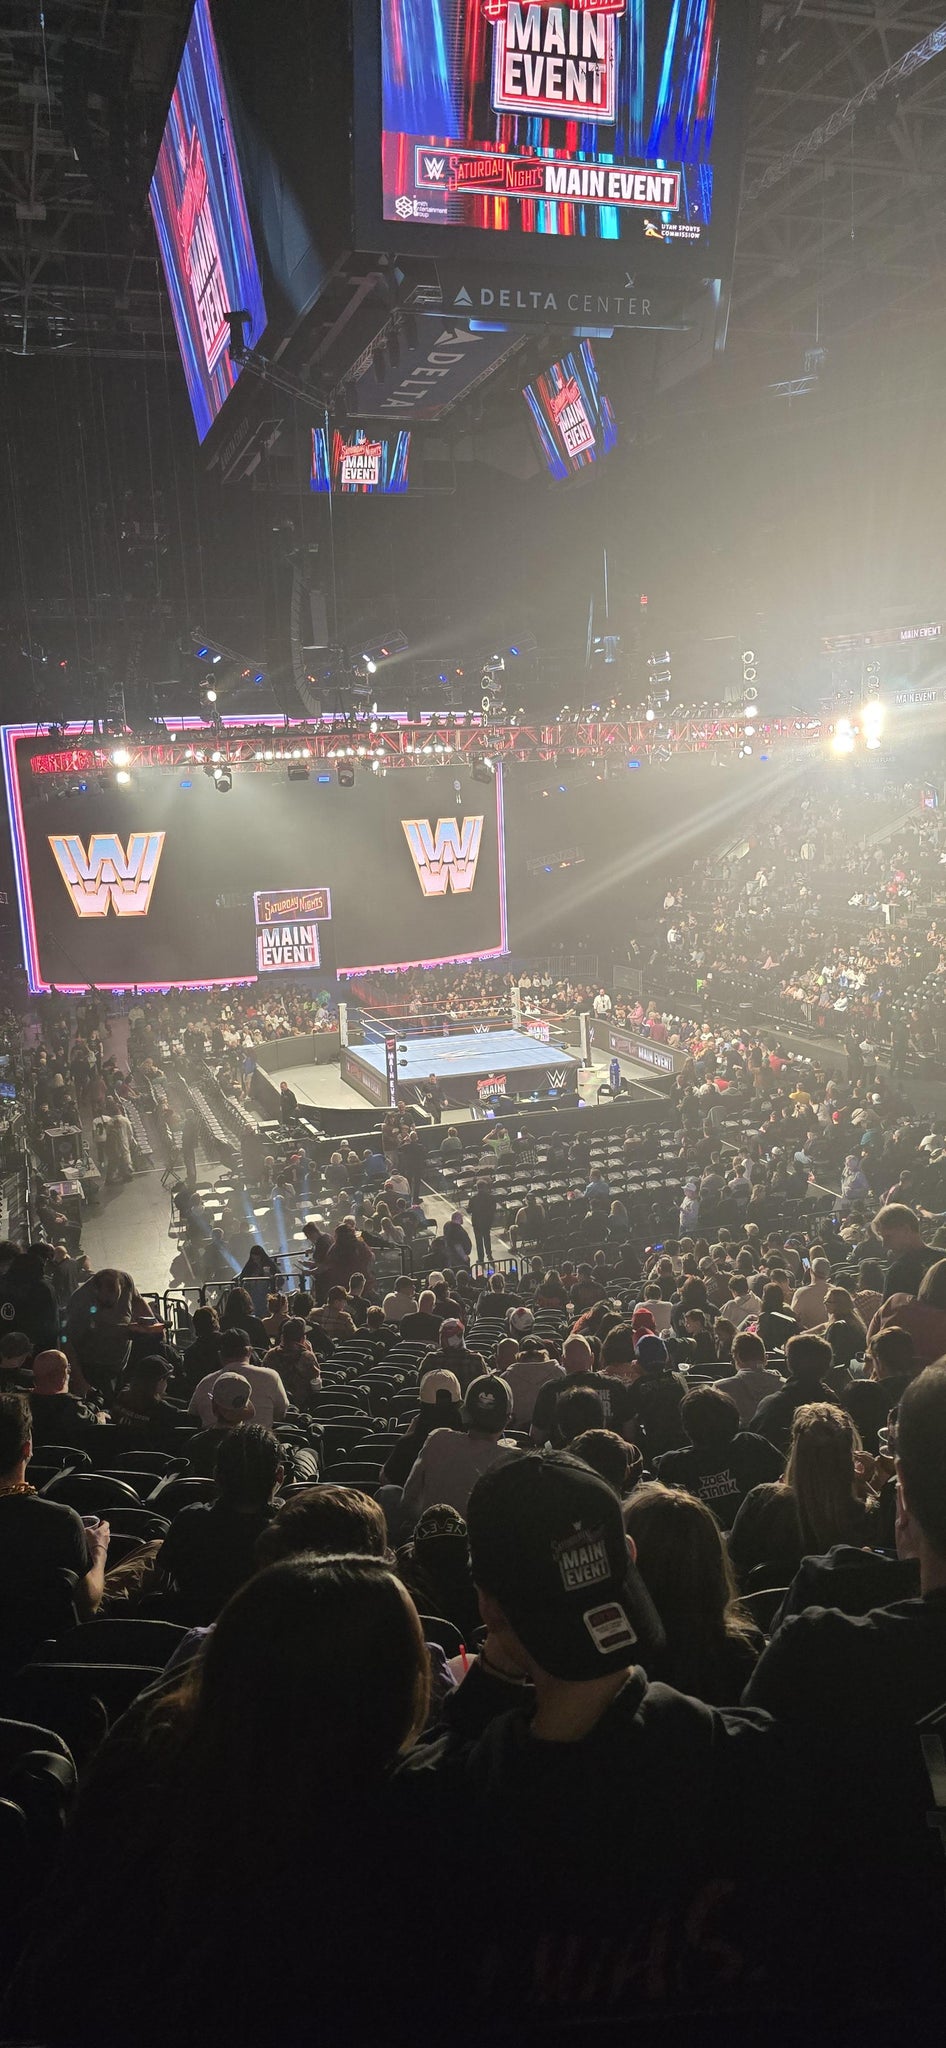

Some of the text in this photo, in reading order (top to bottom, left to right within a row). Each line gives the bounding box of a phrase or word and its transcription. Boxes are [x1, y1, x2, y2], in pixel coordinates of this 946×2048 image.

[506, 1, 606, 59] MAIN
[504, 52, 606, 104] EVENT
[545, 166, 605, 197] MAIN
[608, 172, 675, 203] EVENT
[661, 230, 701, 239] COMMISSION
[480, 288, 651, 316] DELTA CENTER
[380, 352, 465, 410] DELTA
[345, 468, 375, 480] EVENT
[346, 457, 375, 469] MAIN
[900, 626, 942, 641] MAIN EVENT
[896, 691, 937, 703] MAIN EVENT
[264, 896, 299, 921] SATURDAY
[262, 926, 313, 947] MAIN
[263, 945, 314, 965] EVENT
[387, 1053, 395, 1079] MAIN
[638, 1046, 654, 1063] MAIN
[654, 1053, 672, 1071] EVENT
[481, 1084, 505, 1096] MAIN
[700, 1480, 737, 1499] STARK
[701, 1471, 729, 1487] ZOEY
[562, 1541, 603, 1570] MAIN
[565, 1559, 607, 1586] EVENT
